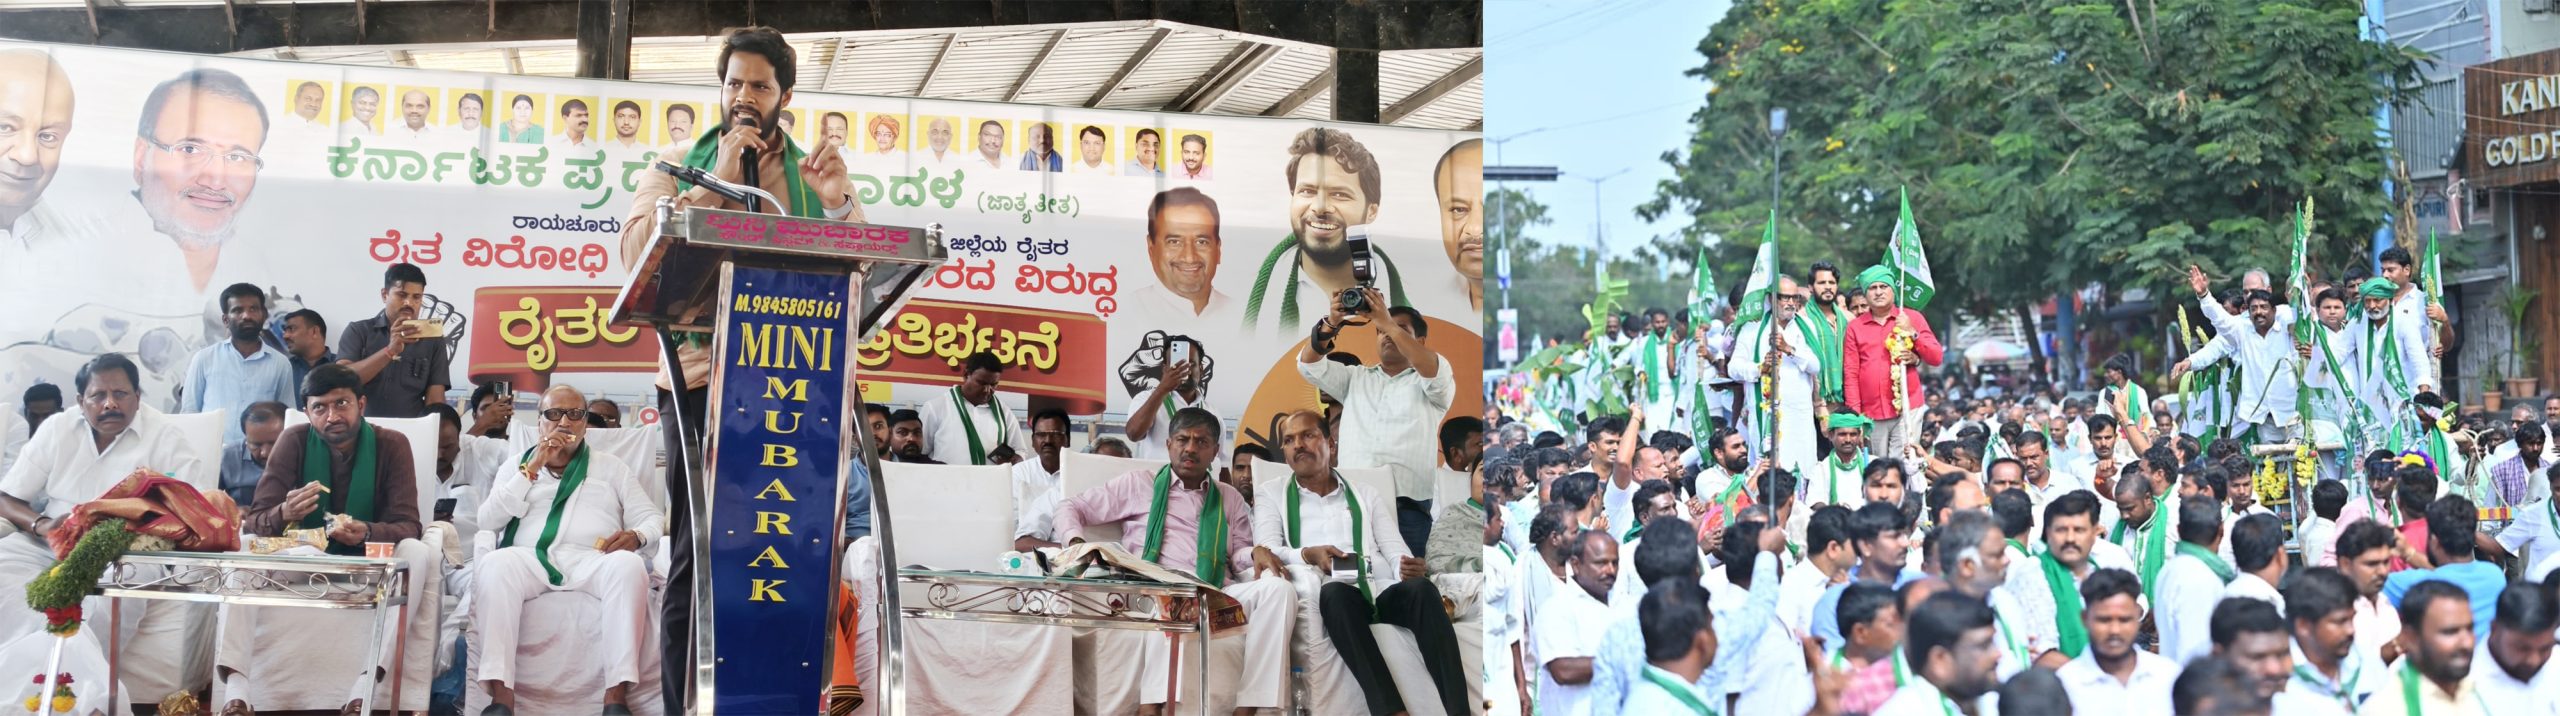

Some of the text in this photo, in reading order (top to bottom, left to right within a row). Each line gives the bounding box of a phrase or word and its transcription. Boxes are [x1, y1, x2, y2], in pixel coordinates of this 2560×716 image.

[2501, 74, 2560, 117] KAN
[326, 137, 549, 188] ಕರ್ನಾಟಕ
[2485, 132, 2548, 168] GOLD
[462, 235, 609, 278] ವಿರೋಧಿ
[512, 213, 1069, 262] ರಾಯಚೂರು ಜಿಲ್ಲೆಯ ರೈತರ
[734, 293, 842, 319] M.9845805161
[736, 321, 834, 372] MINI
[747, 376, 810, 602] MUBARAK
